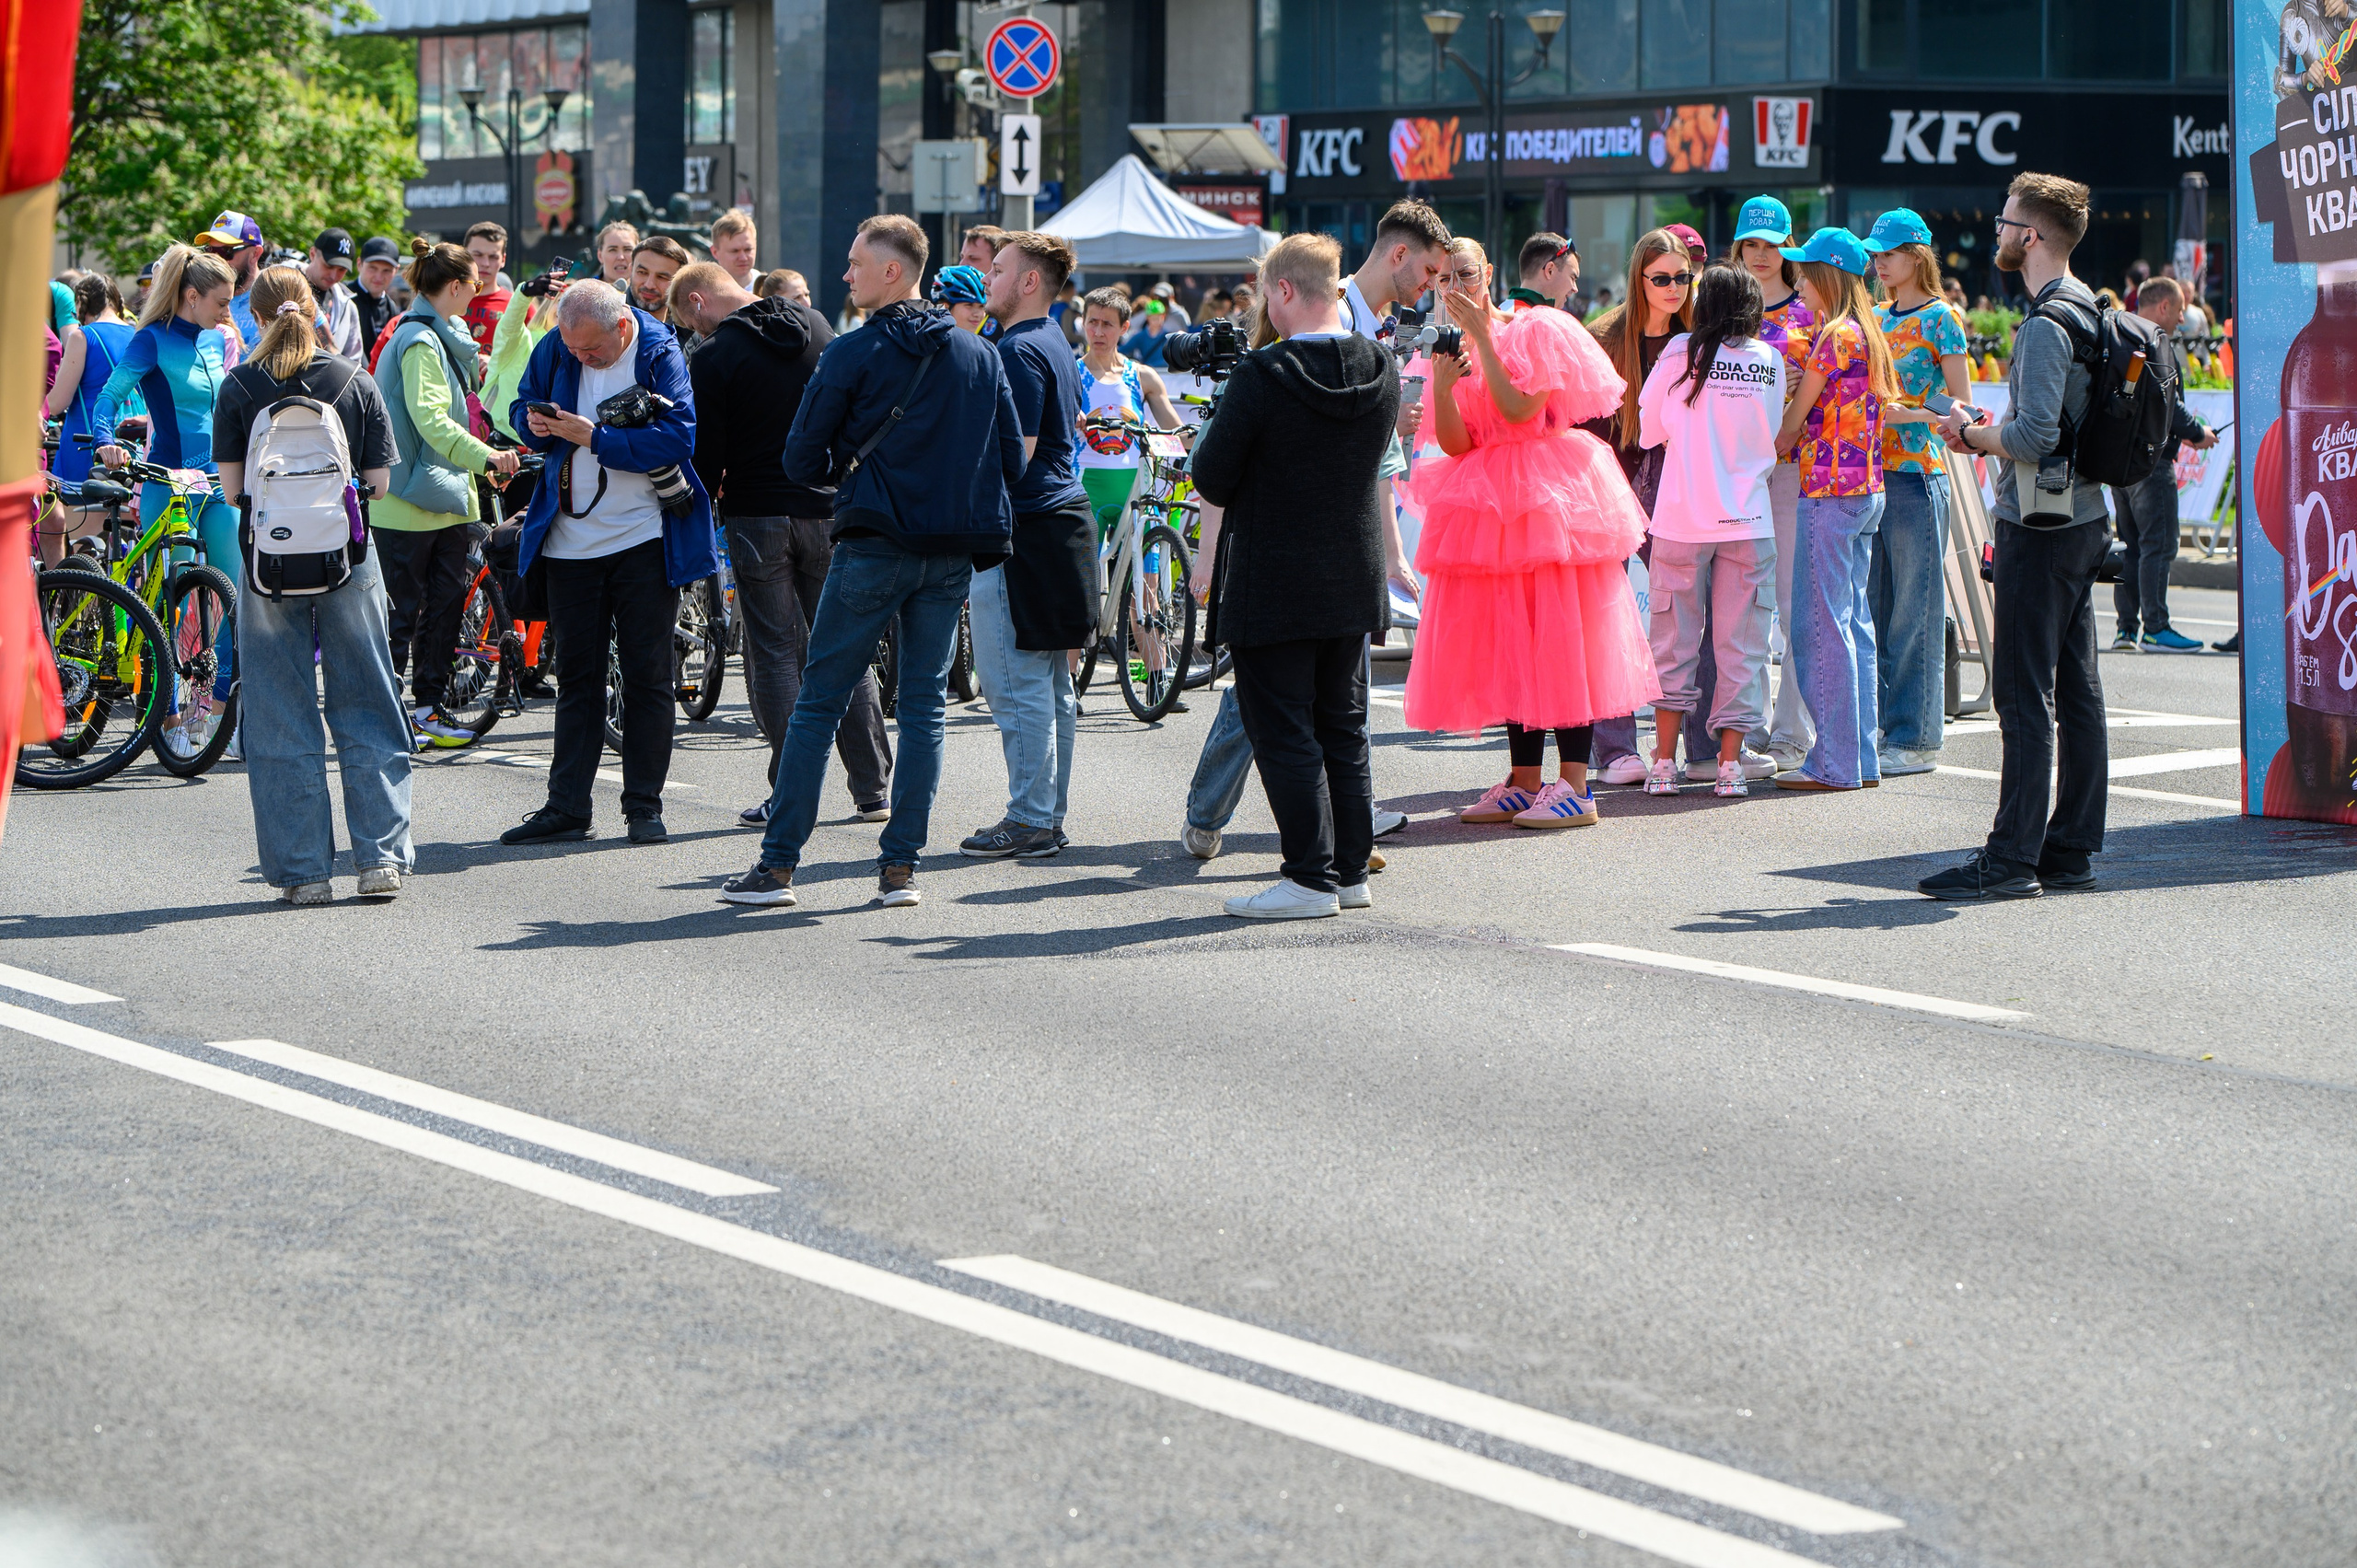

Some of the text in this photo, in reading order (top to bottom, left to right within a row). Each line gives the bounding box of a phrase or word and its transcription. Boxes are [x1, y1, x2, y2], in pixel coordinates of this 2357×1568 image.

[1505, 116, 1643, 164] ПОБЕДИТЕЛЕЙ
[1881, 110, 2022, 165] KFC
[1295, 128, 1364, 177] KFC
[1765, 148, 1801, 163] KFC
[1178, 191, 1260, 206] МИНСК
[1748, 208, 1776, 218] ПЕРШЫ
[1748, 218, 1773, 226] РОВАР
[1711, 360, 1776, 377] EDIA ONE
[561, 459, 569, 490] Cano
